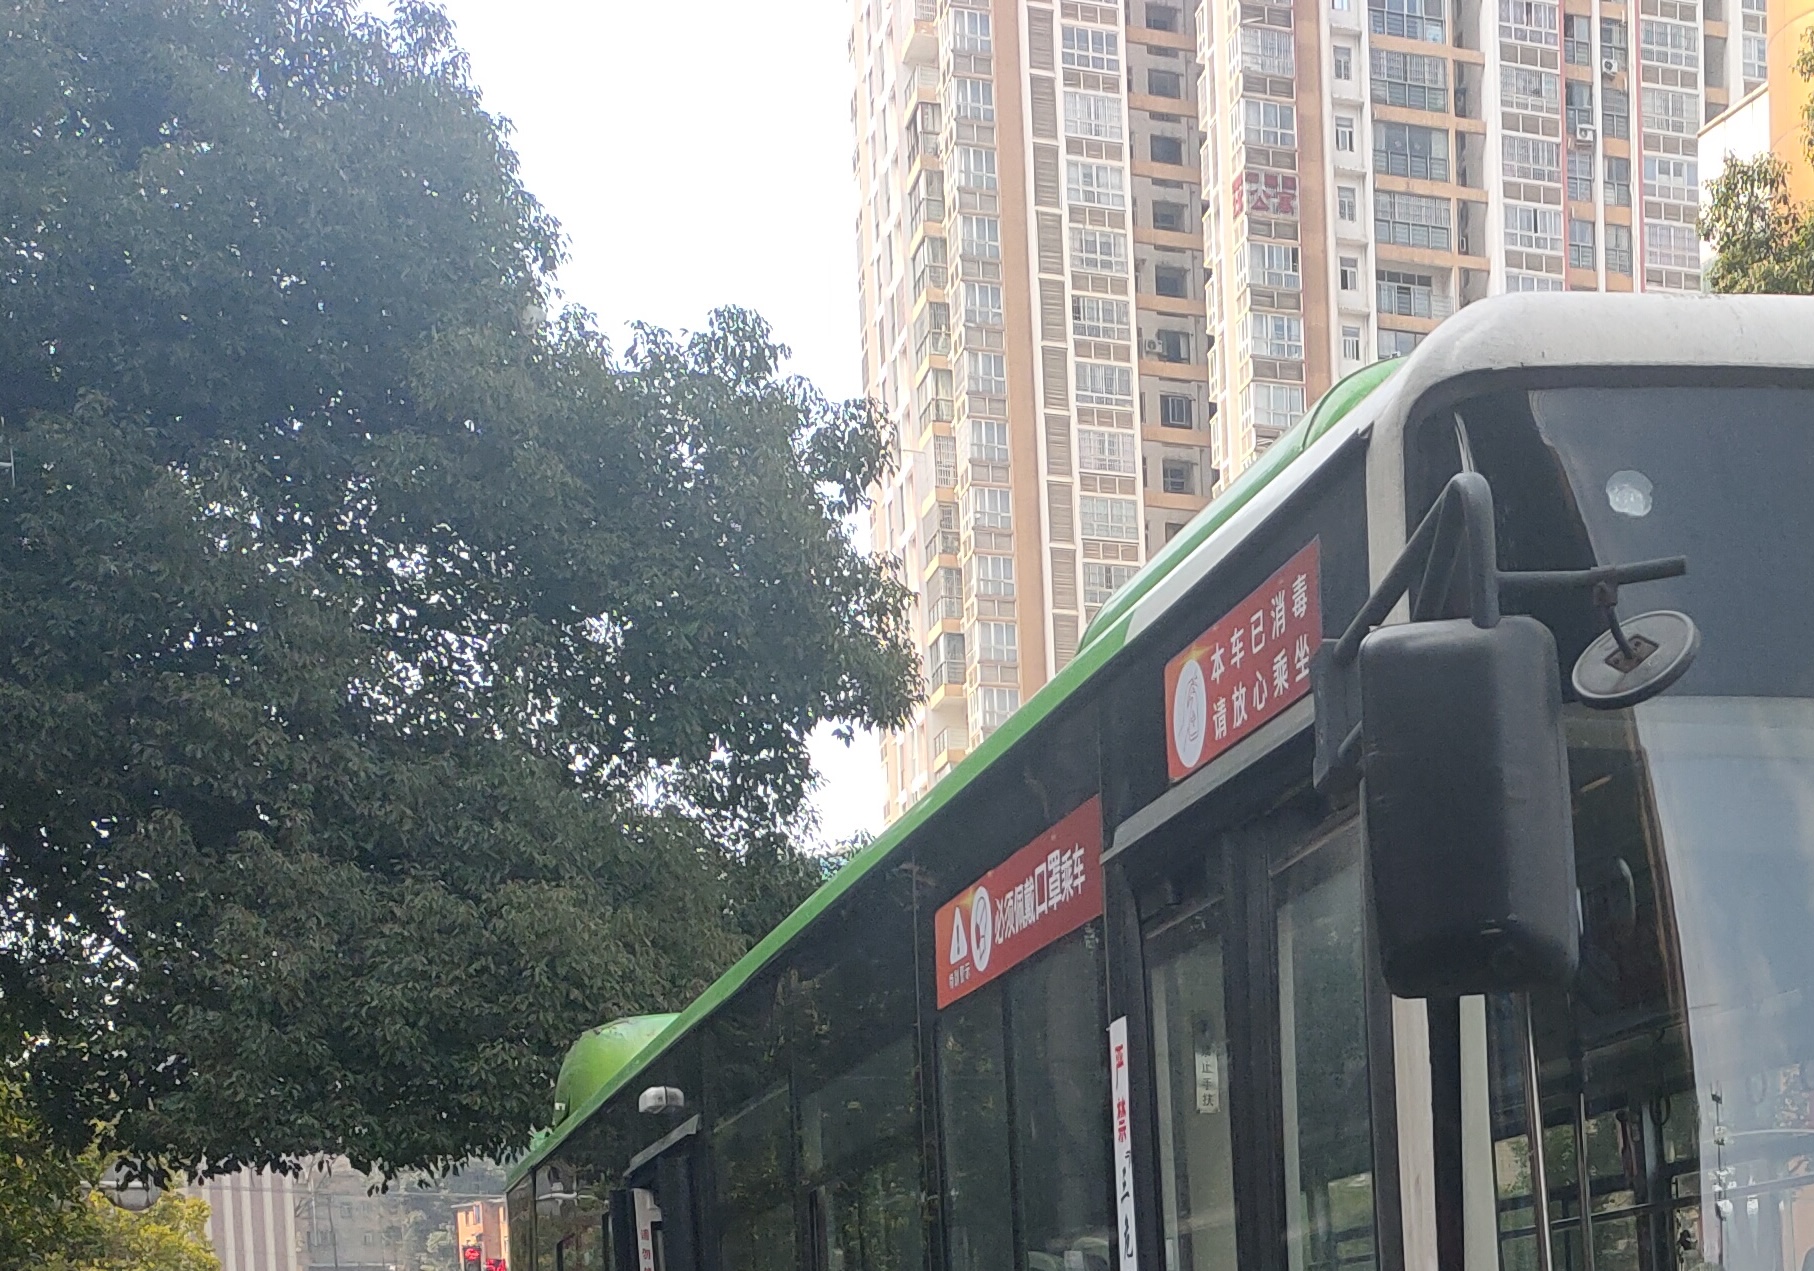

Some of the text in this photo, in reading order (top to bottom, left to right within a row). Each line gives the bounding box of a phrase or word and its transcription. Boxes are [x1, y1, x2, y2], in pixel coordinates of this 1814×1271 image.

[1210, 573, 1308, 684] 本车已消毒
[1212, 633, 1310, 740] 请放心乘坐
[994, 842, 1086, 945] 必须佩戴口罩乘车
